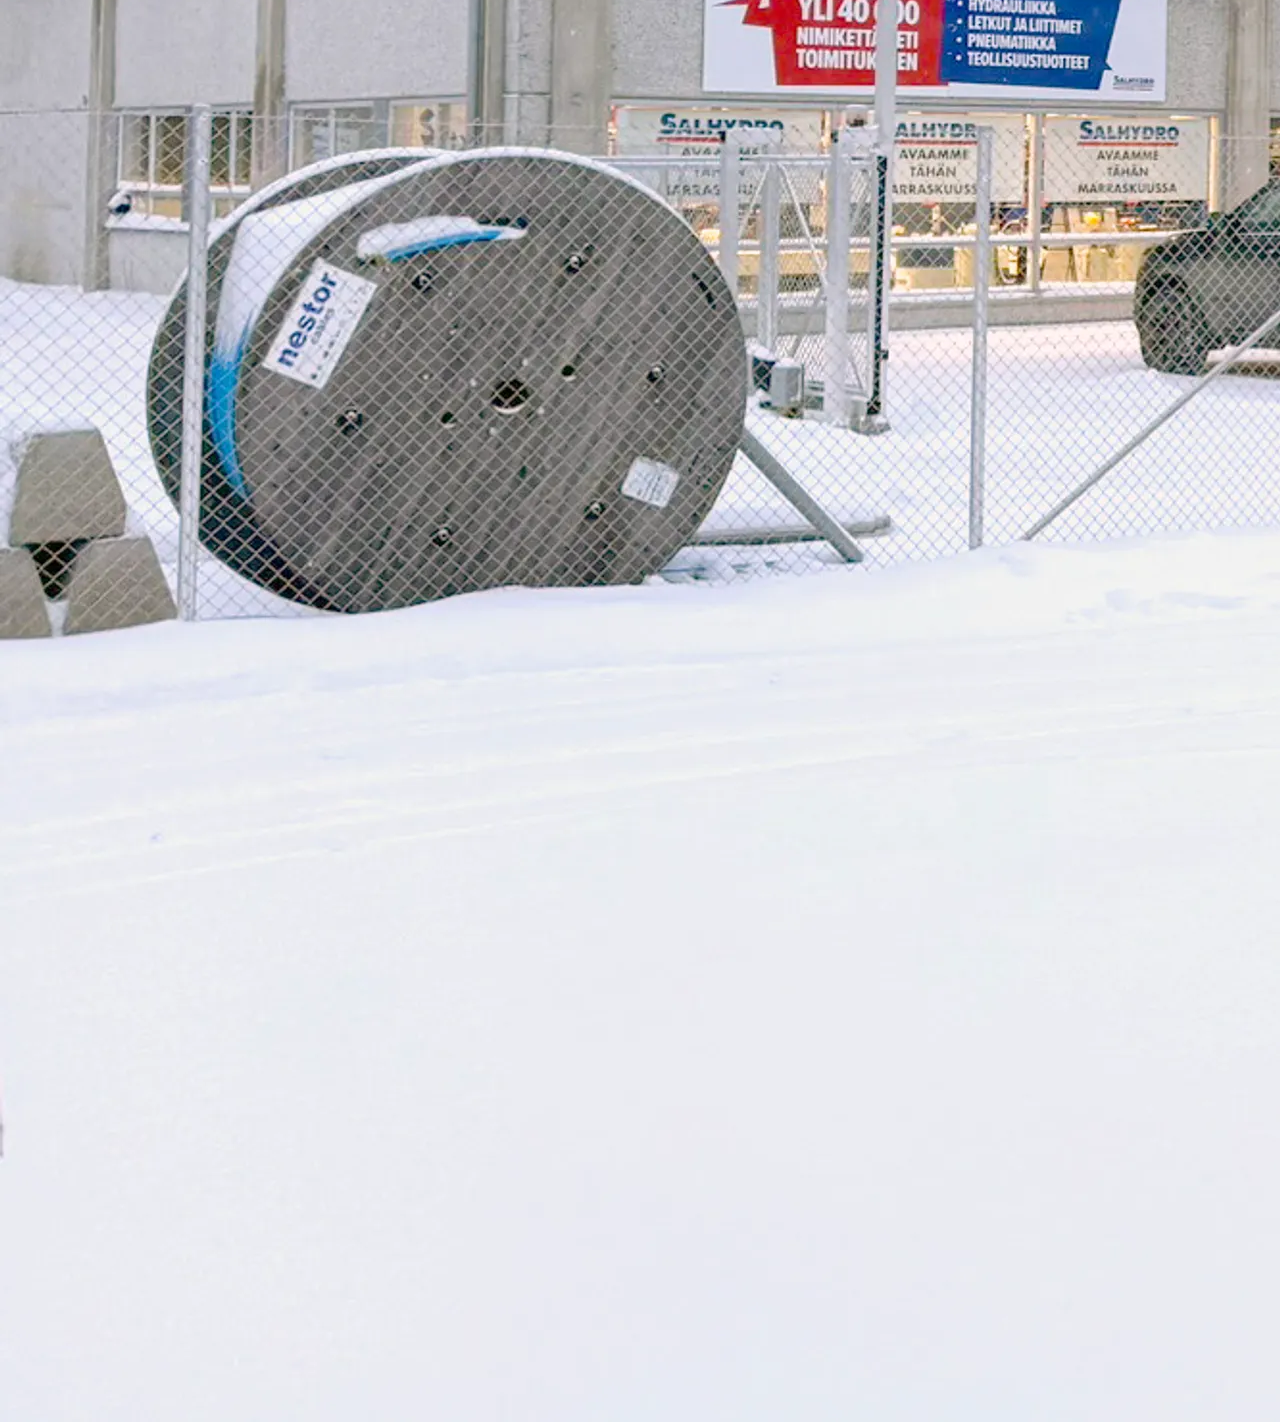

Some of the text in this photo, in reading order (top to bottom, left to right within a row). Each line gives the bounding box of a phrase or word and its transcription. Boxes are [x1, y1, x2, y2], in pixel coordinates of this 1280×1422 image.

[967, 15, 1083, 35] LETKUT JA LIITTIMET
[896, 30, 919, 49] ETI
[967, 33, 1057, 51] PNEUMATIIKKA
[796, 48, 919, 71] TOIMITUKEN
[967, 51, 1091, 70] TEOLLISUUSTUOTTEET
[894, 122, 977, 138] ALHYDR
[1079, 120, 1180, 140] SALHYDRO
[898, 148, 970, 160] AVAAMME
[1096, 149, 1160, 161] AVAAMME
[910, 162, 957, 178] TÄHÄN
[1107, 165, 1149, 177] TÄHÄN
[892, 183, 977, 195] ARRASKUUSS
[1077, 182, 1178, 194] MARRASKUUSSA
[276, 271, 337, 367] nestor
